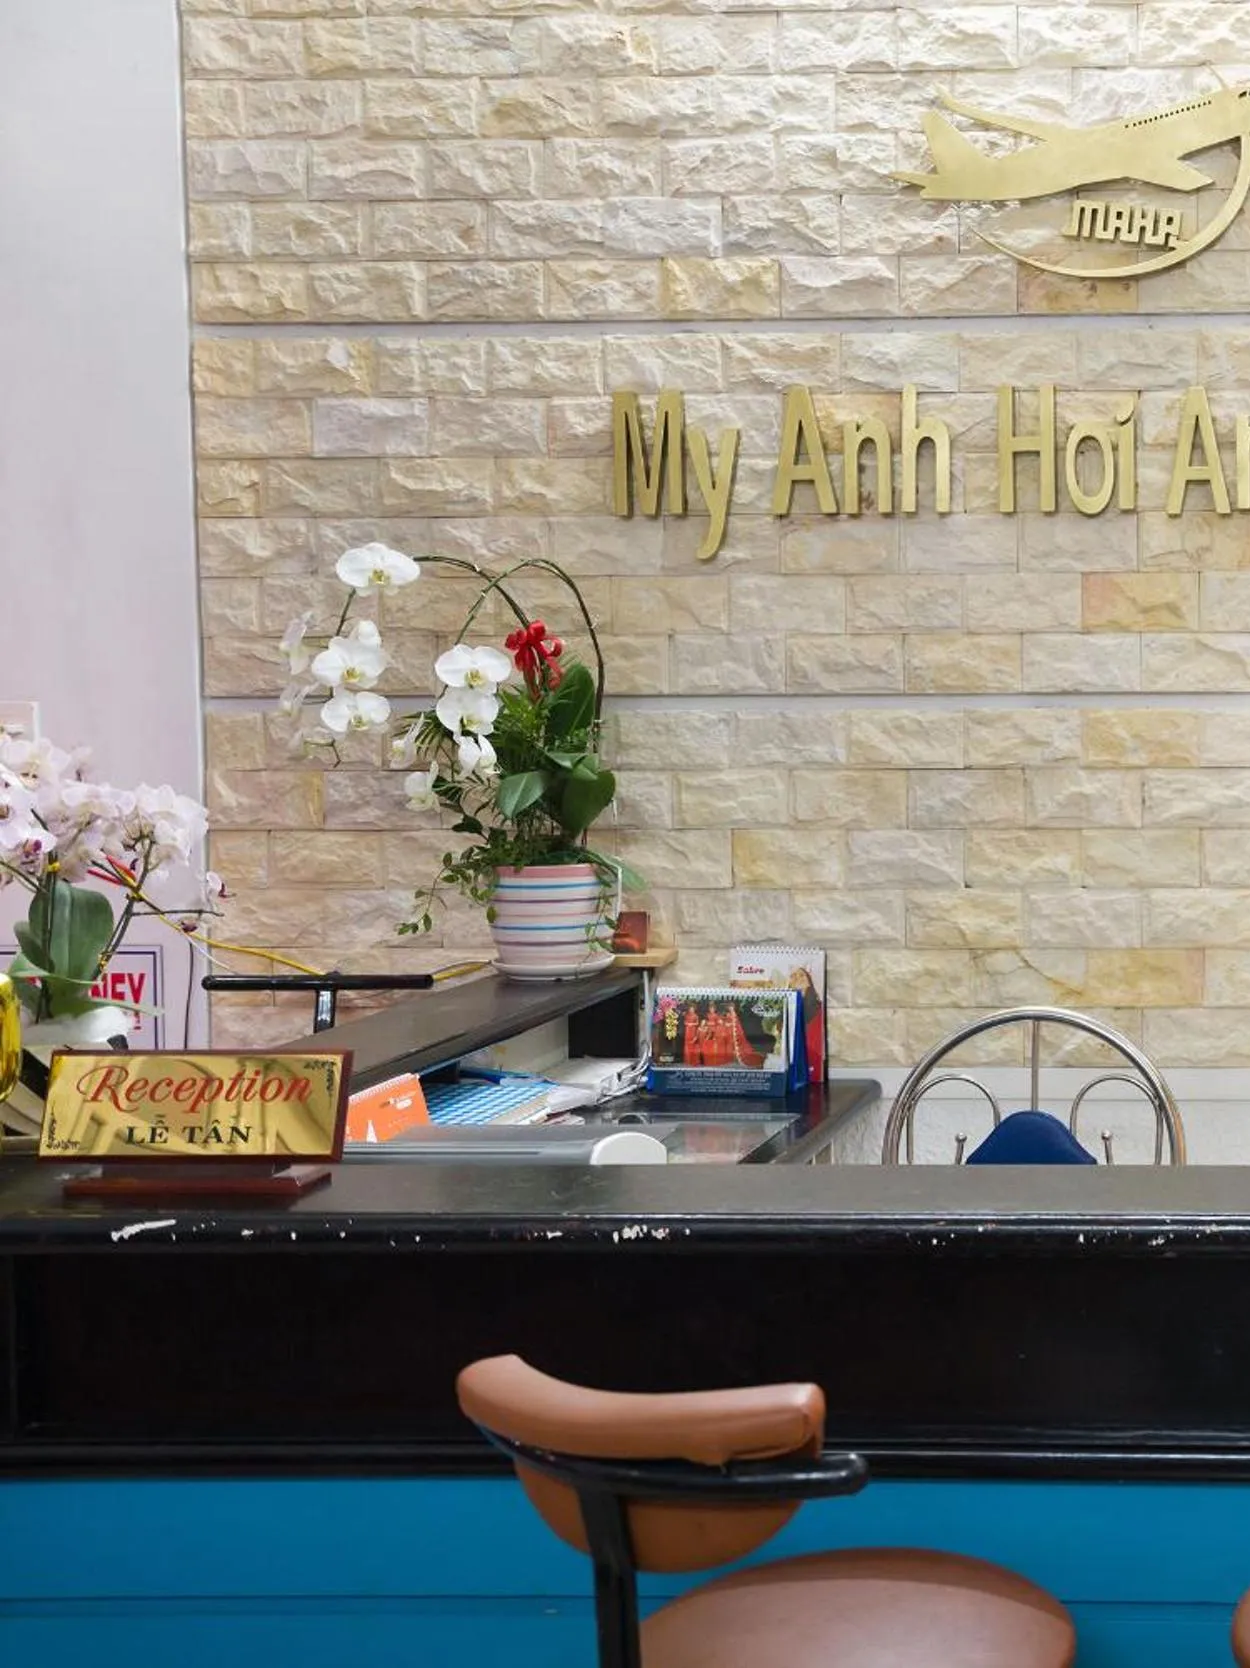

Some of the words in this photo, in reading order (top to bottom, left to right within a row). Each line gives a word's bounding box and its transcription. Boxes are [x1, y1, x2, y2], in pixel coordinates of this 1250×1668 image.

[611, 384, 742, 560] My
[771, 383, 952, 515] Anh
[76, 1064, 313, 1114] Reception
[126, 1114, 169, 1145] LỄ
[182, 1117, 253, 1145] TÂN
